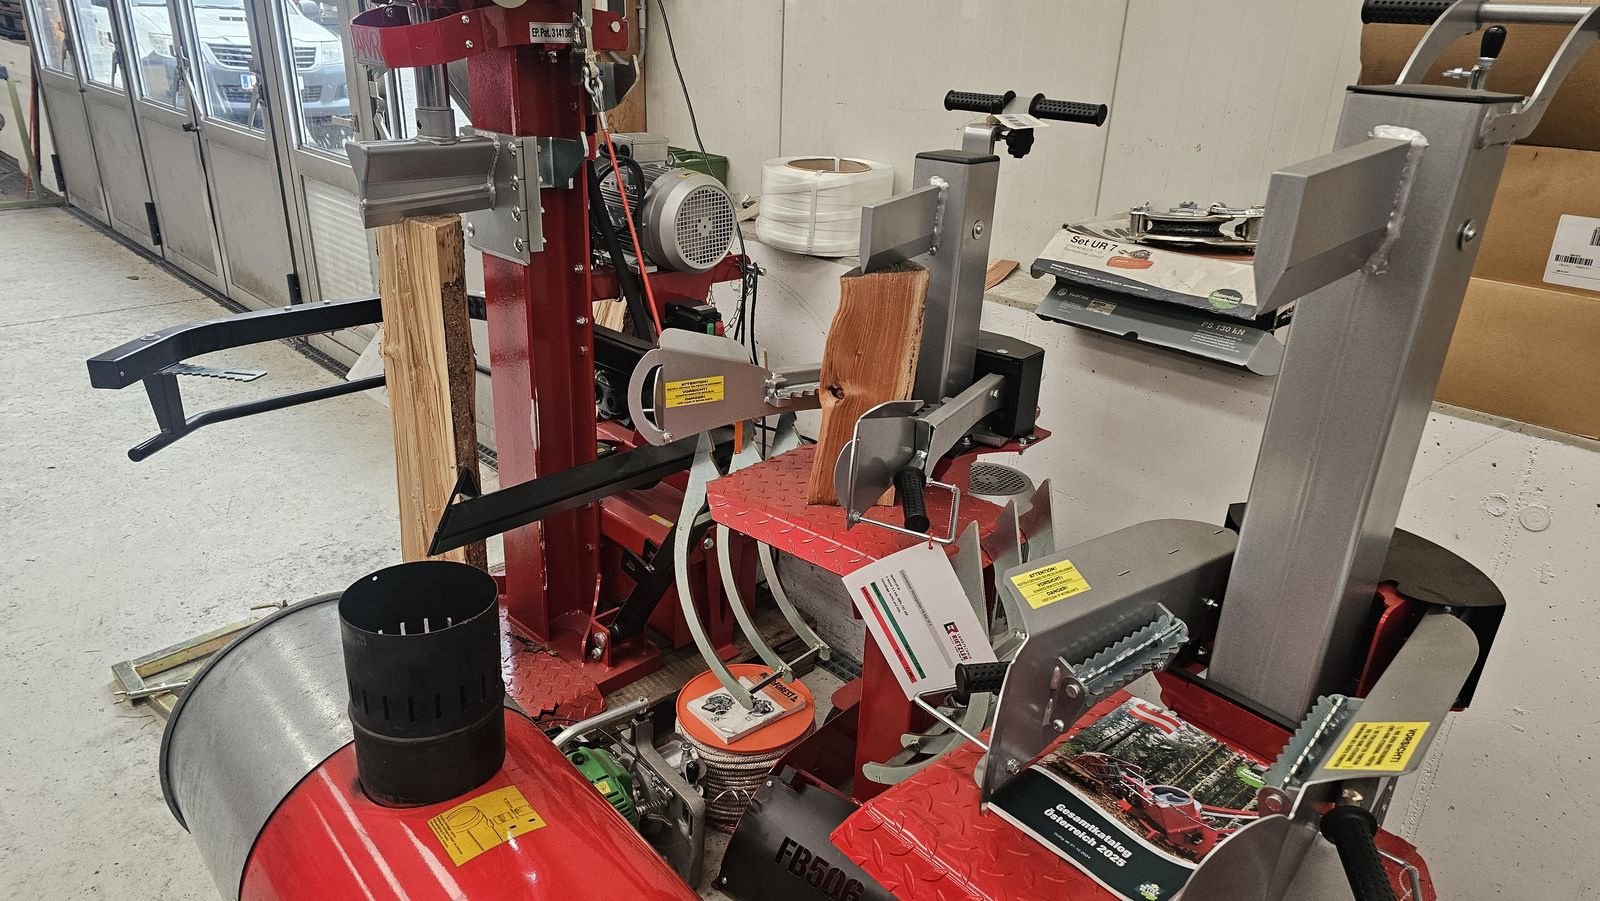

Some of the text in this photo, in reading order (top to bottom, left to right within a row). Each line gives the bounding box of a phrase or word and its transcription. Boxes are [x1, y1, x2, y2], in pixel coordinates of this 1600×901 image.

[1070, 235, 1090, 246] Set
[1091, 239, 1108, 251] UR
[1110, 244, 1119, 252] 7
[1201, 321, 1246, 336] PS 130 kN
[1389, 728, 1418, 763] VORSICHT!
[1043, 807, 1126, 868] Österreich 2025
[1055, 803, 1133, 858] Gesamtkatalog
[774, 836, 865, 901] FB506
